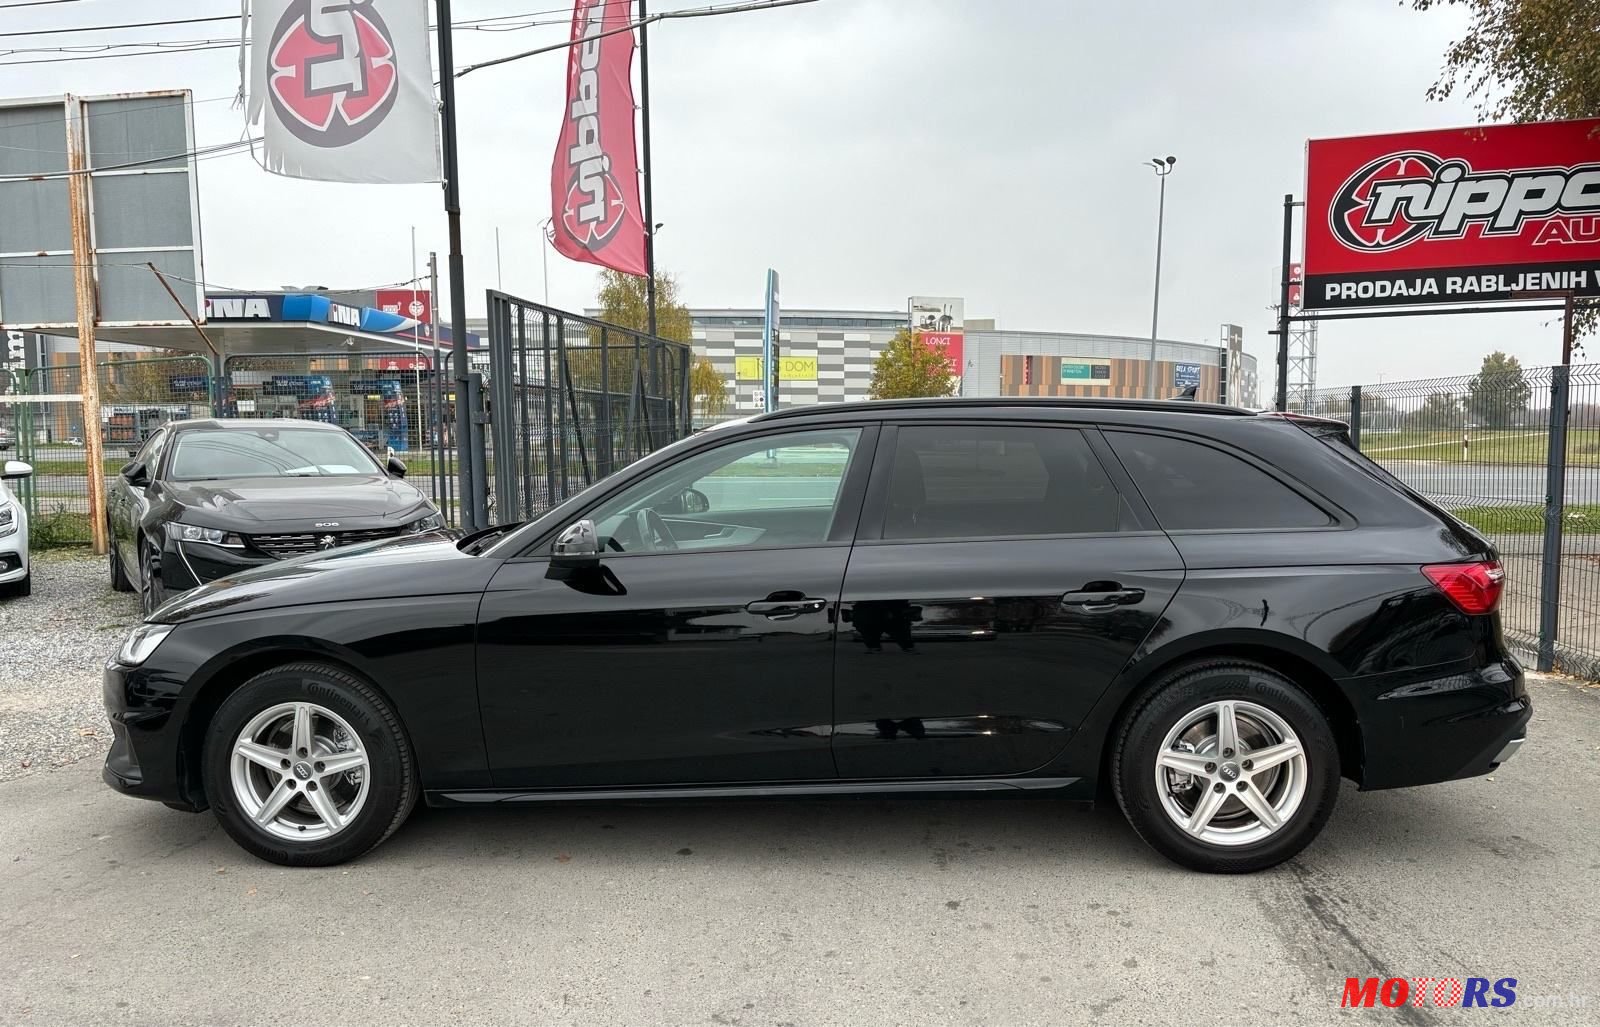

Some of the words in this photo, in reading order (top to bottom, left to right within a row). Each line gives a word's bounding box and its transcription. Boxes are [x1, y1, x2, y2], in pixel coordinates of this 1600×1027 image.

[1325, 276, 1439, 302] PRODAJA
[1446, 269, 1588, 296] RABLJENIH
[785, 361, 814, 372] DOM
